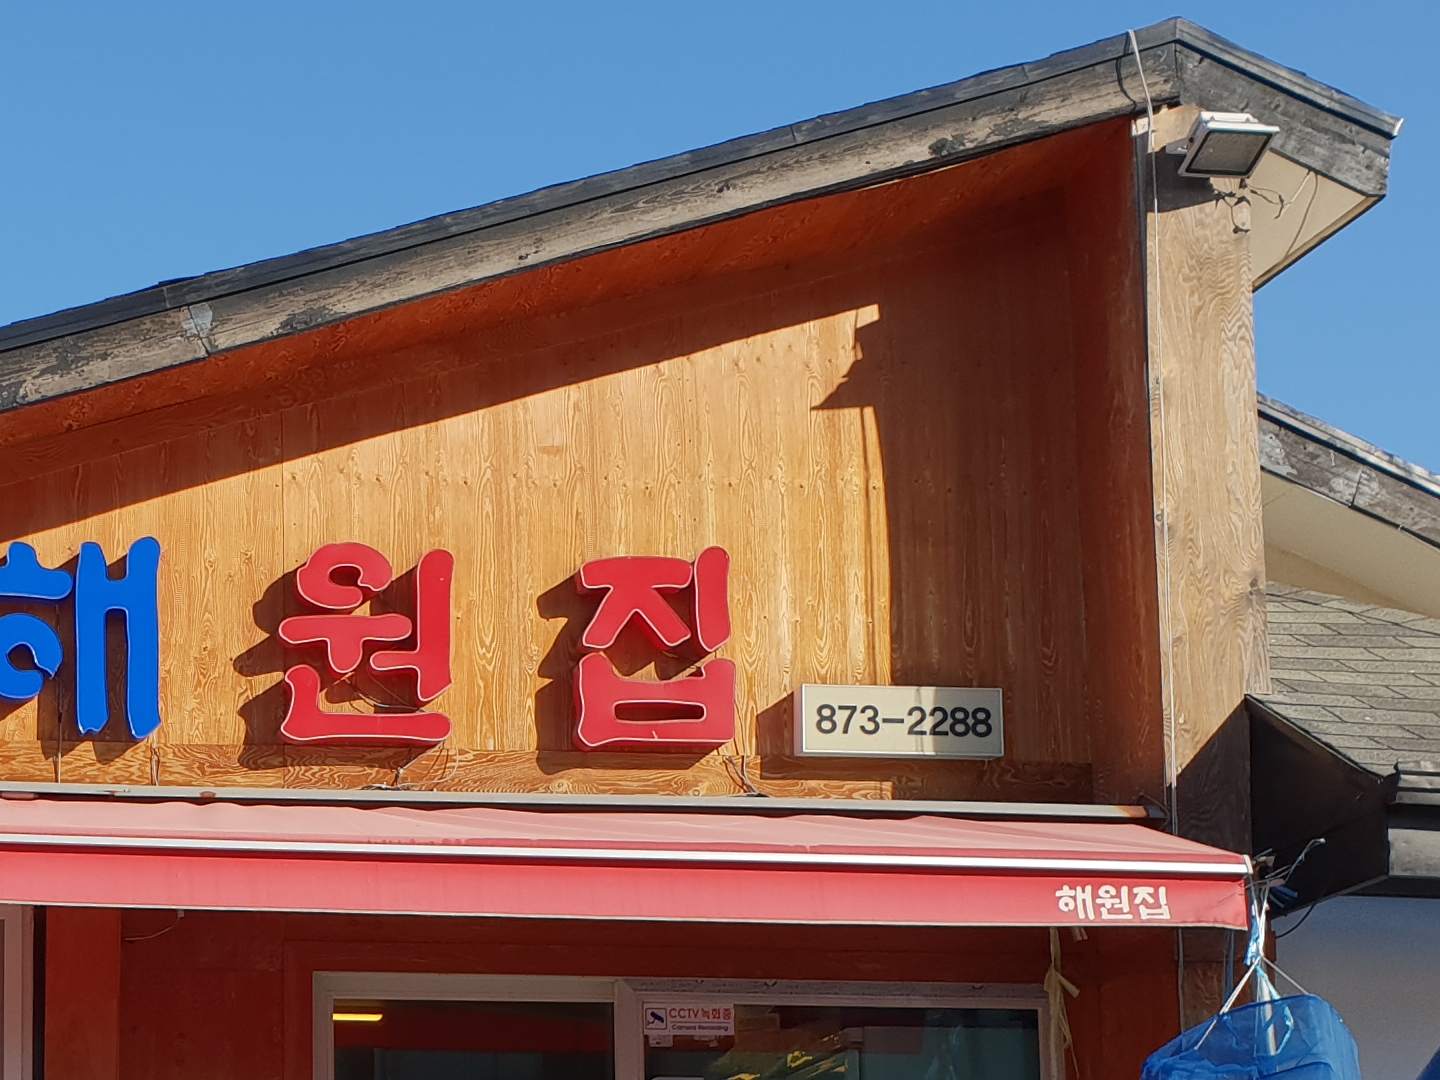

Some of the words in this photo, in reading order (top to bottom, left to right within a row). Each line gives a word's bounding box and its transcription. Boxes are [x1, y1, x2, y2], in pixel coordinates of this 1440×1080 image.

[816, 704, 992, 737] 873-2288
[1055, 885, 1171, 920] 해원집
[669, 1008, 699, 1018] CCTV
